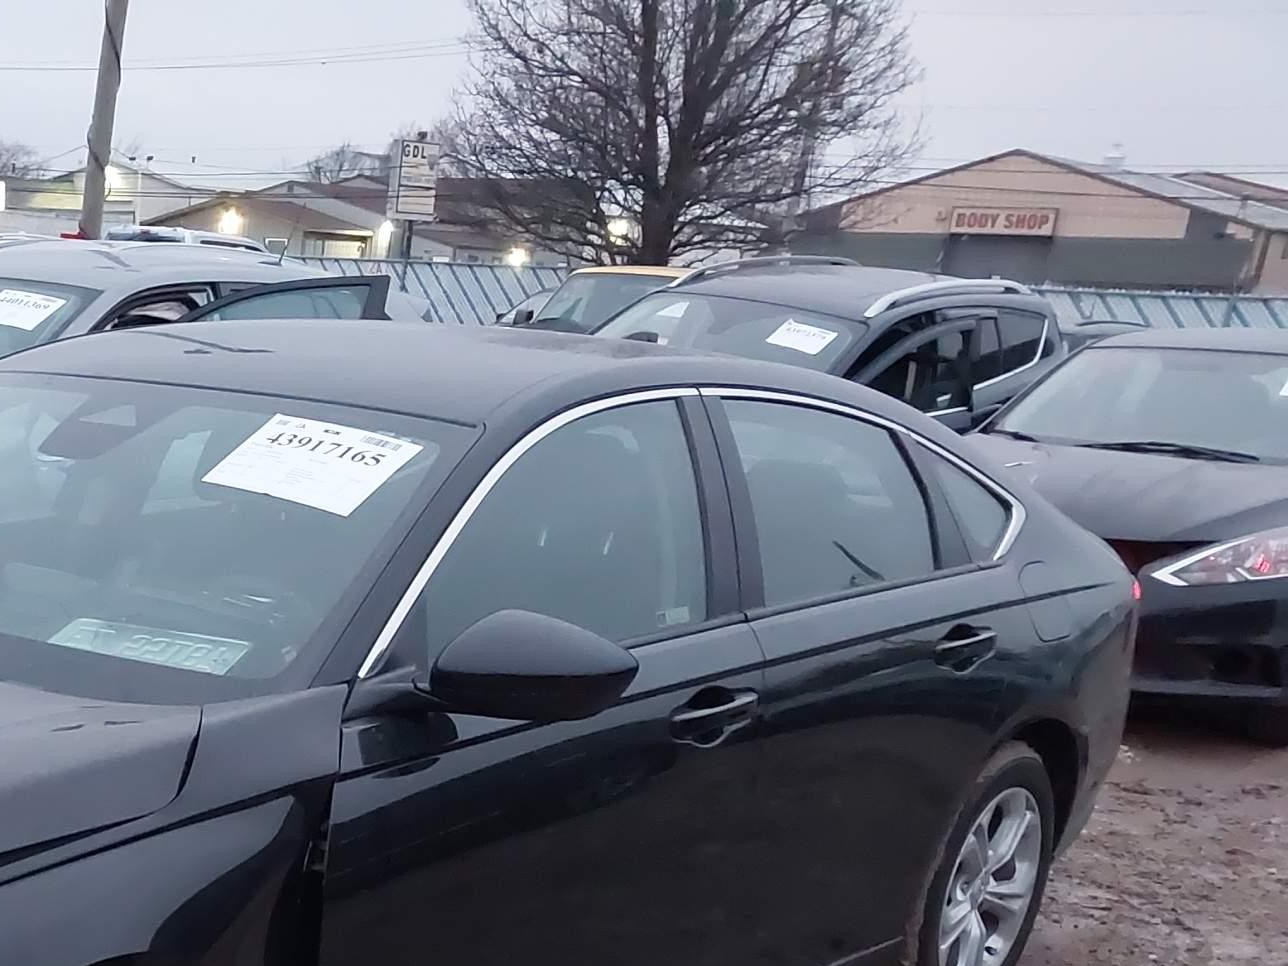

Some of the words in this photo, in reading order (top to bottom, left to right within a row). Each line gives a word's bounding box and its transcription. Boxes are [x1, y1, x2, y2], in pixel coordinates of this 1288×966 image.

[955, 212, 999, 229] BODY
[1003, 213, 1050, 230] SHOP
[265, 431, 388, 467] 43917165
